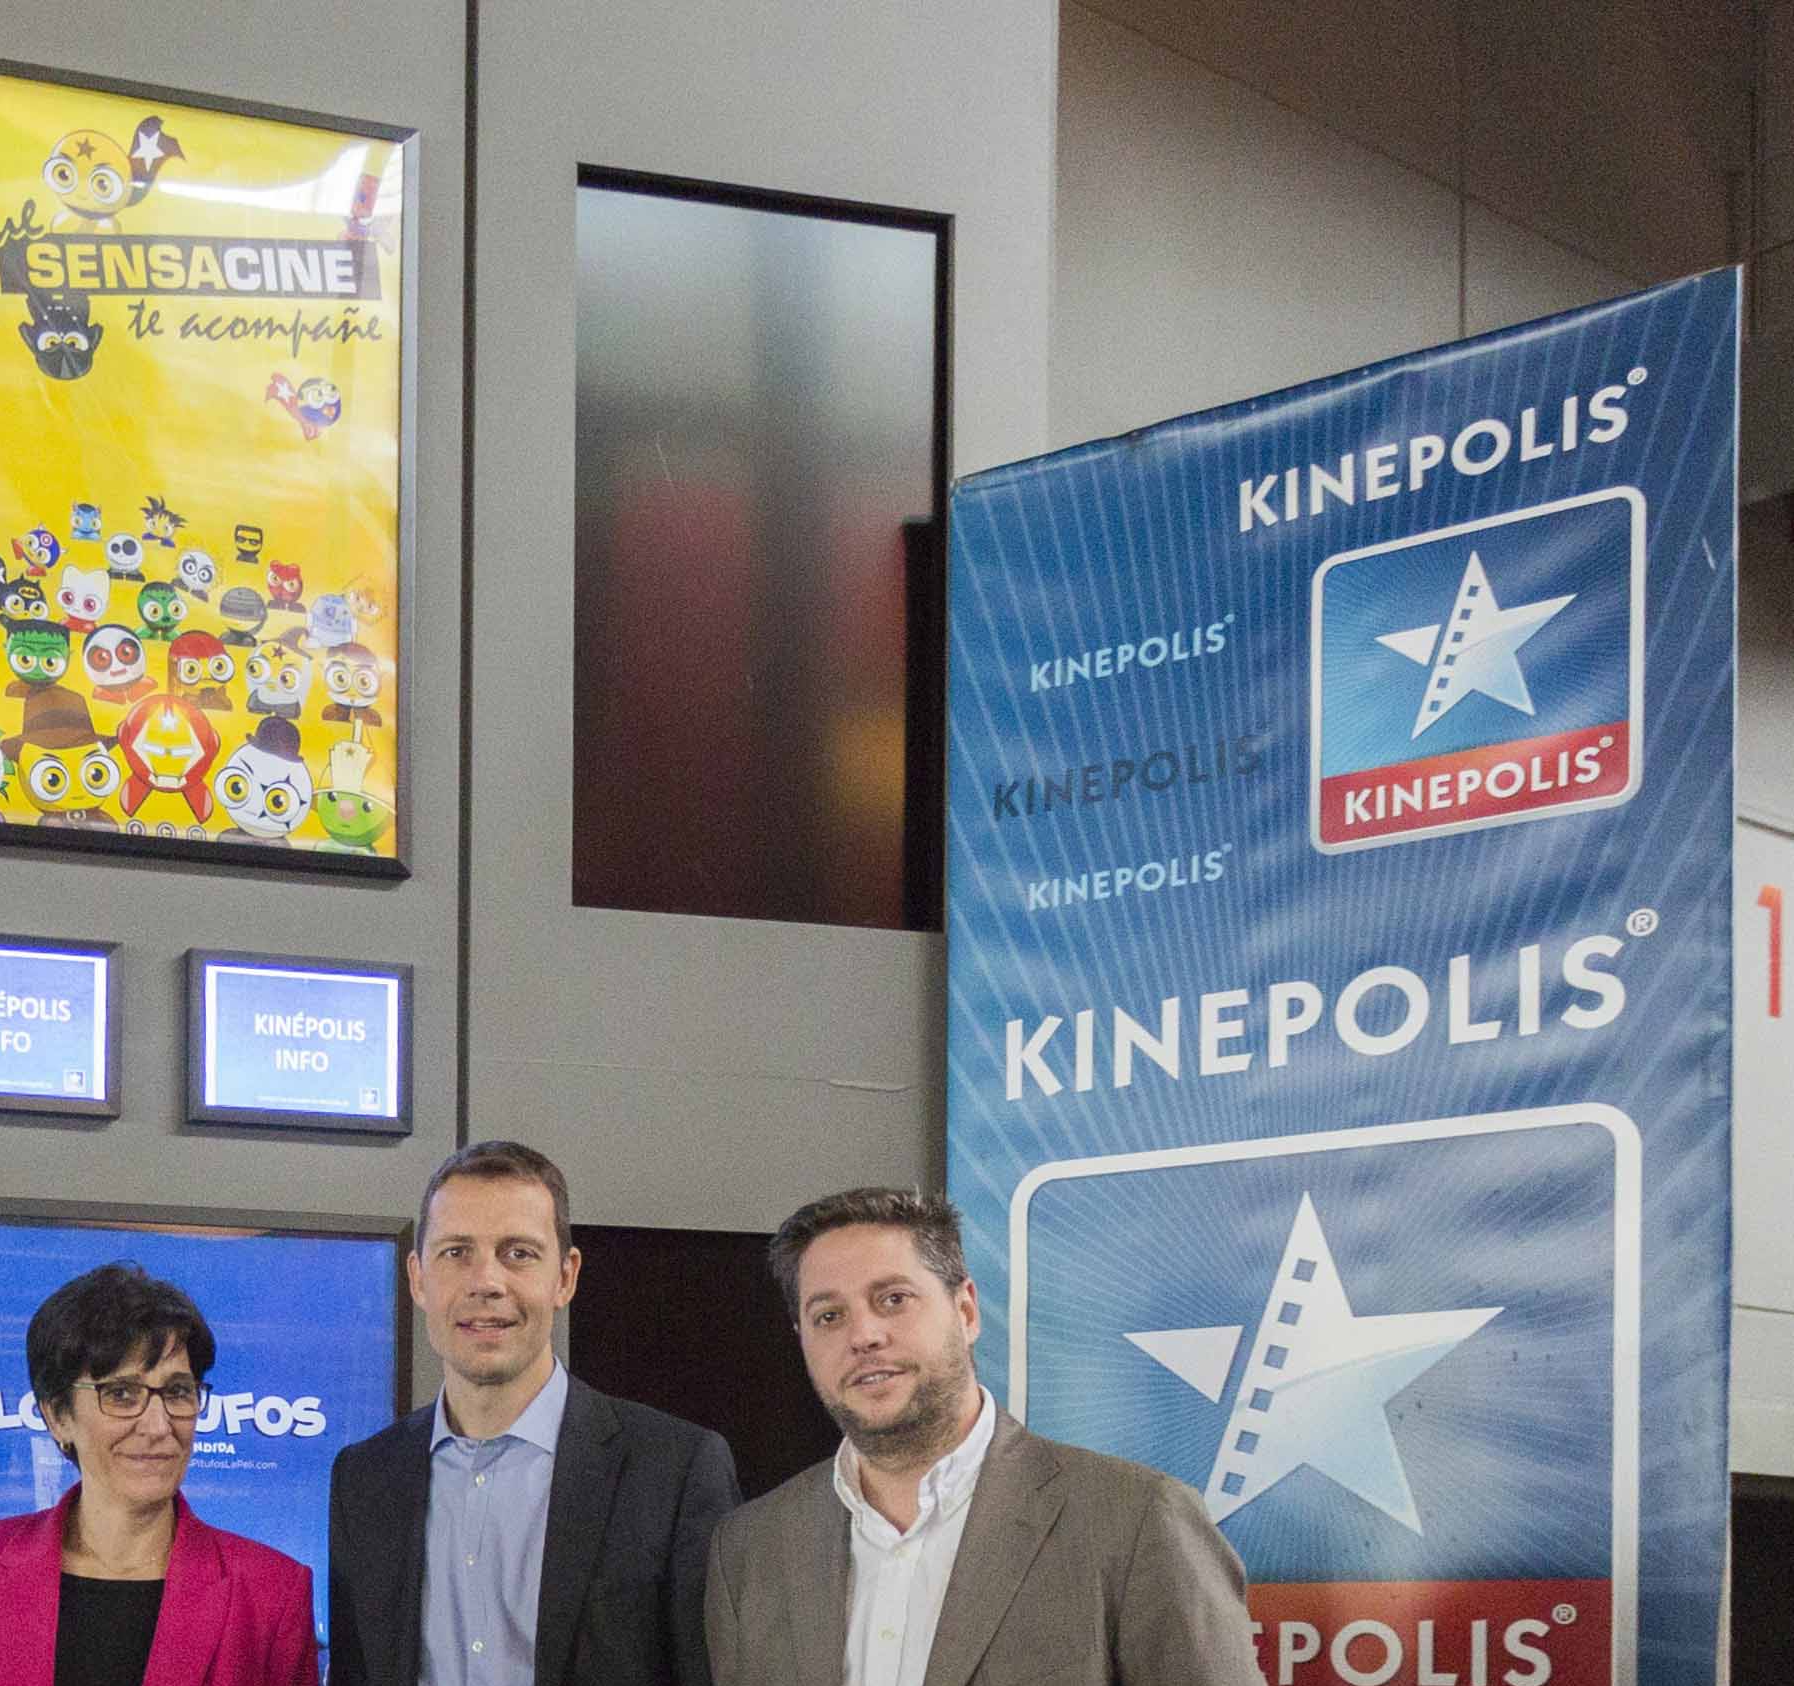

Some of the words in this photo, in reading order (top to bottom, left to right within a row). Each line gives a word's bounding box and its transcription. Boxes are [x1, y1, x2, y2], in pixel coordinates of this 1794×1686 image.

[26, 242, 358, 294] SENSACINE
[128, 300, 164, 340] te
[179, 306, 383, 358] acompañe
[1030, 622, 1226, 692] KINEPOLIS
[993, 735, 1263, 821] KINEPOLIS
[1344, 746, 1601, 826] KINEPOLIS
[1028, 850, 1224, 912] KINEPOLIS
[254, 1010, 366, 1042] KINÉPOLIS
[275, 1049, 329, 1073] INFO
[195, 1390, 326, 1437] UFOS
[192, 1441, 236, 1456] NDIDA
